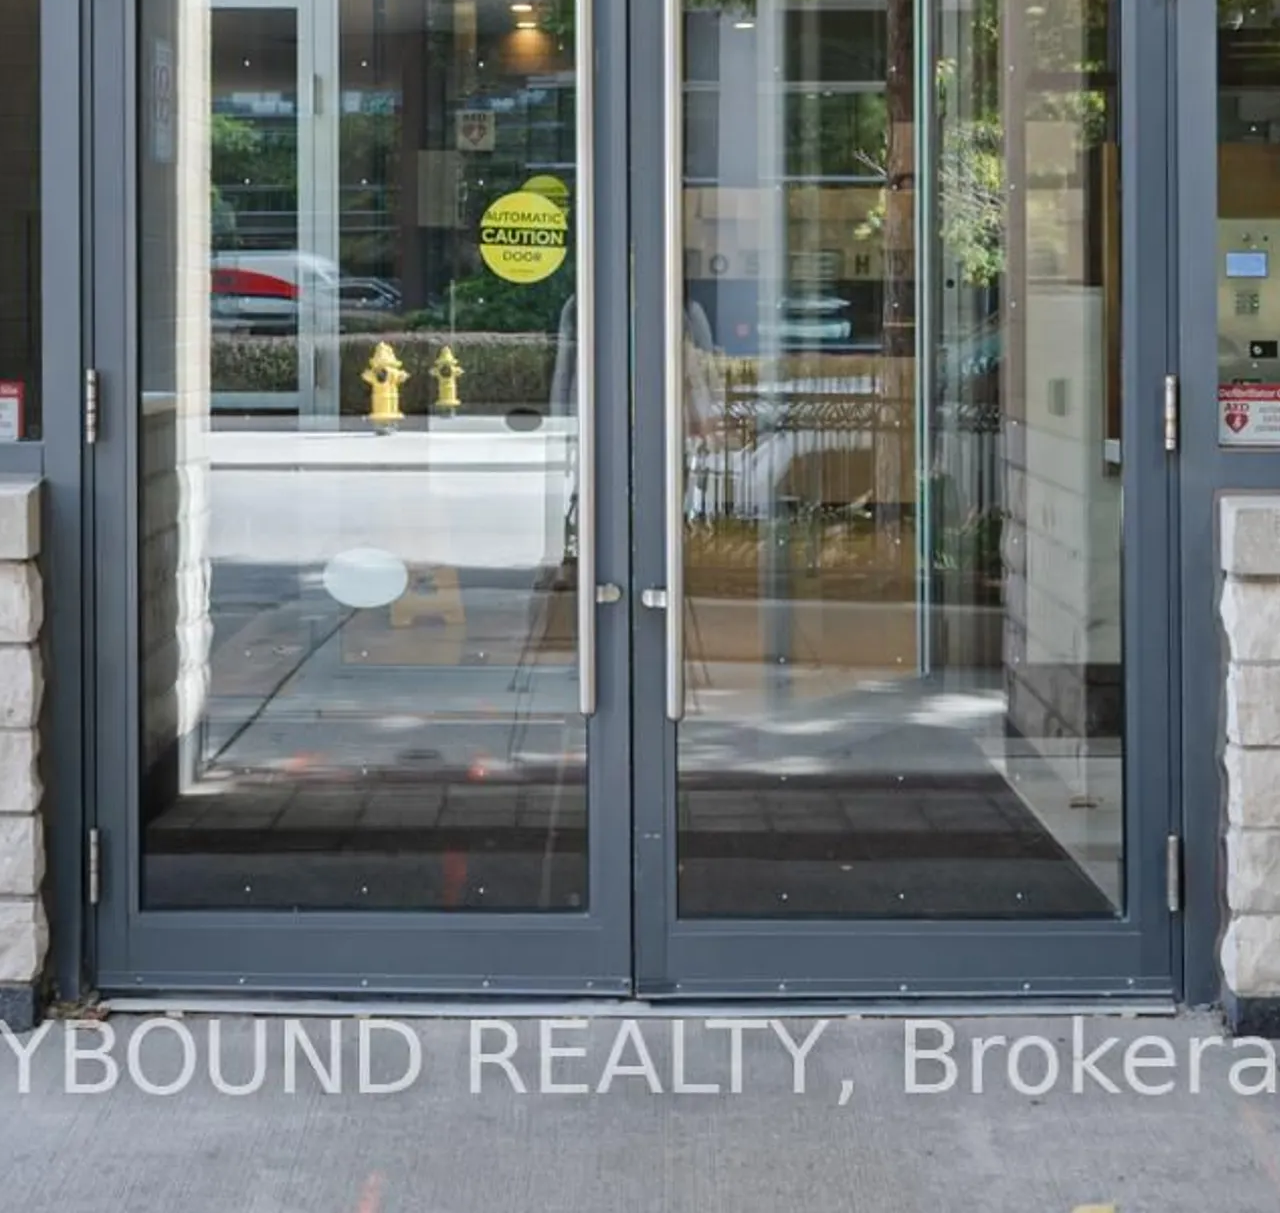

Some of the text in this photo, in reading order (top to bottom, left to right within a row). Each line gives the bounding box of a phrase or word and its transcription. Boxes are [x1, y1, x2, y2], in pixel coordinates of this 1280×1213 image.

[485, 210, 561, 225] AUTOMATIC
[481, 228, 564, 245] CAUTION
[1224, 402, 1249, 412] AED
